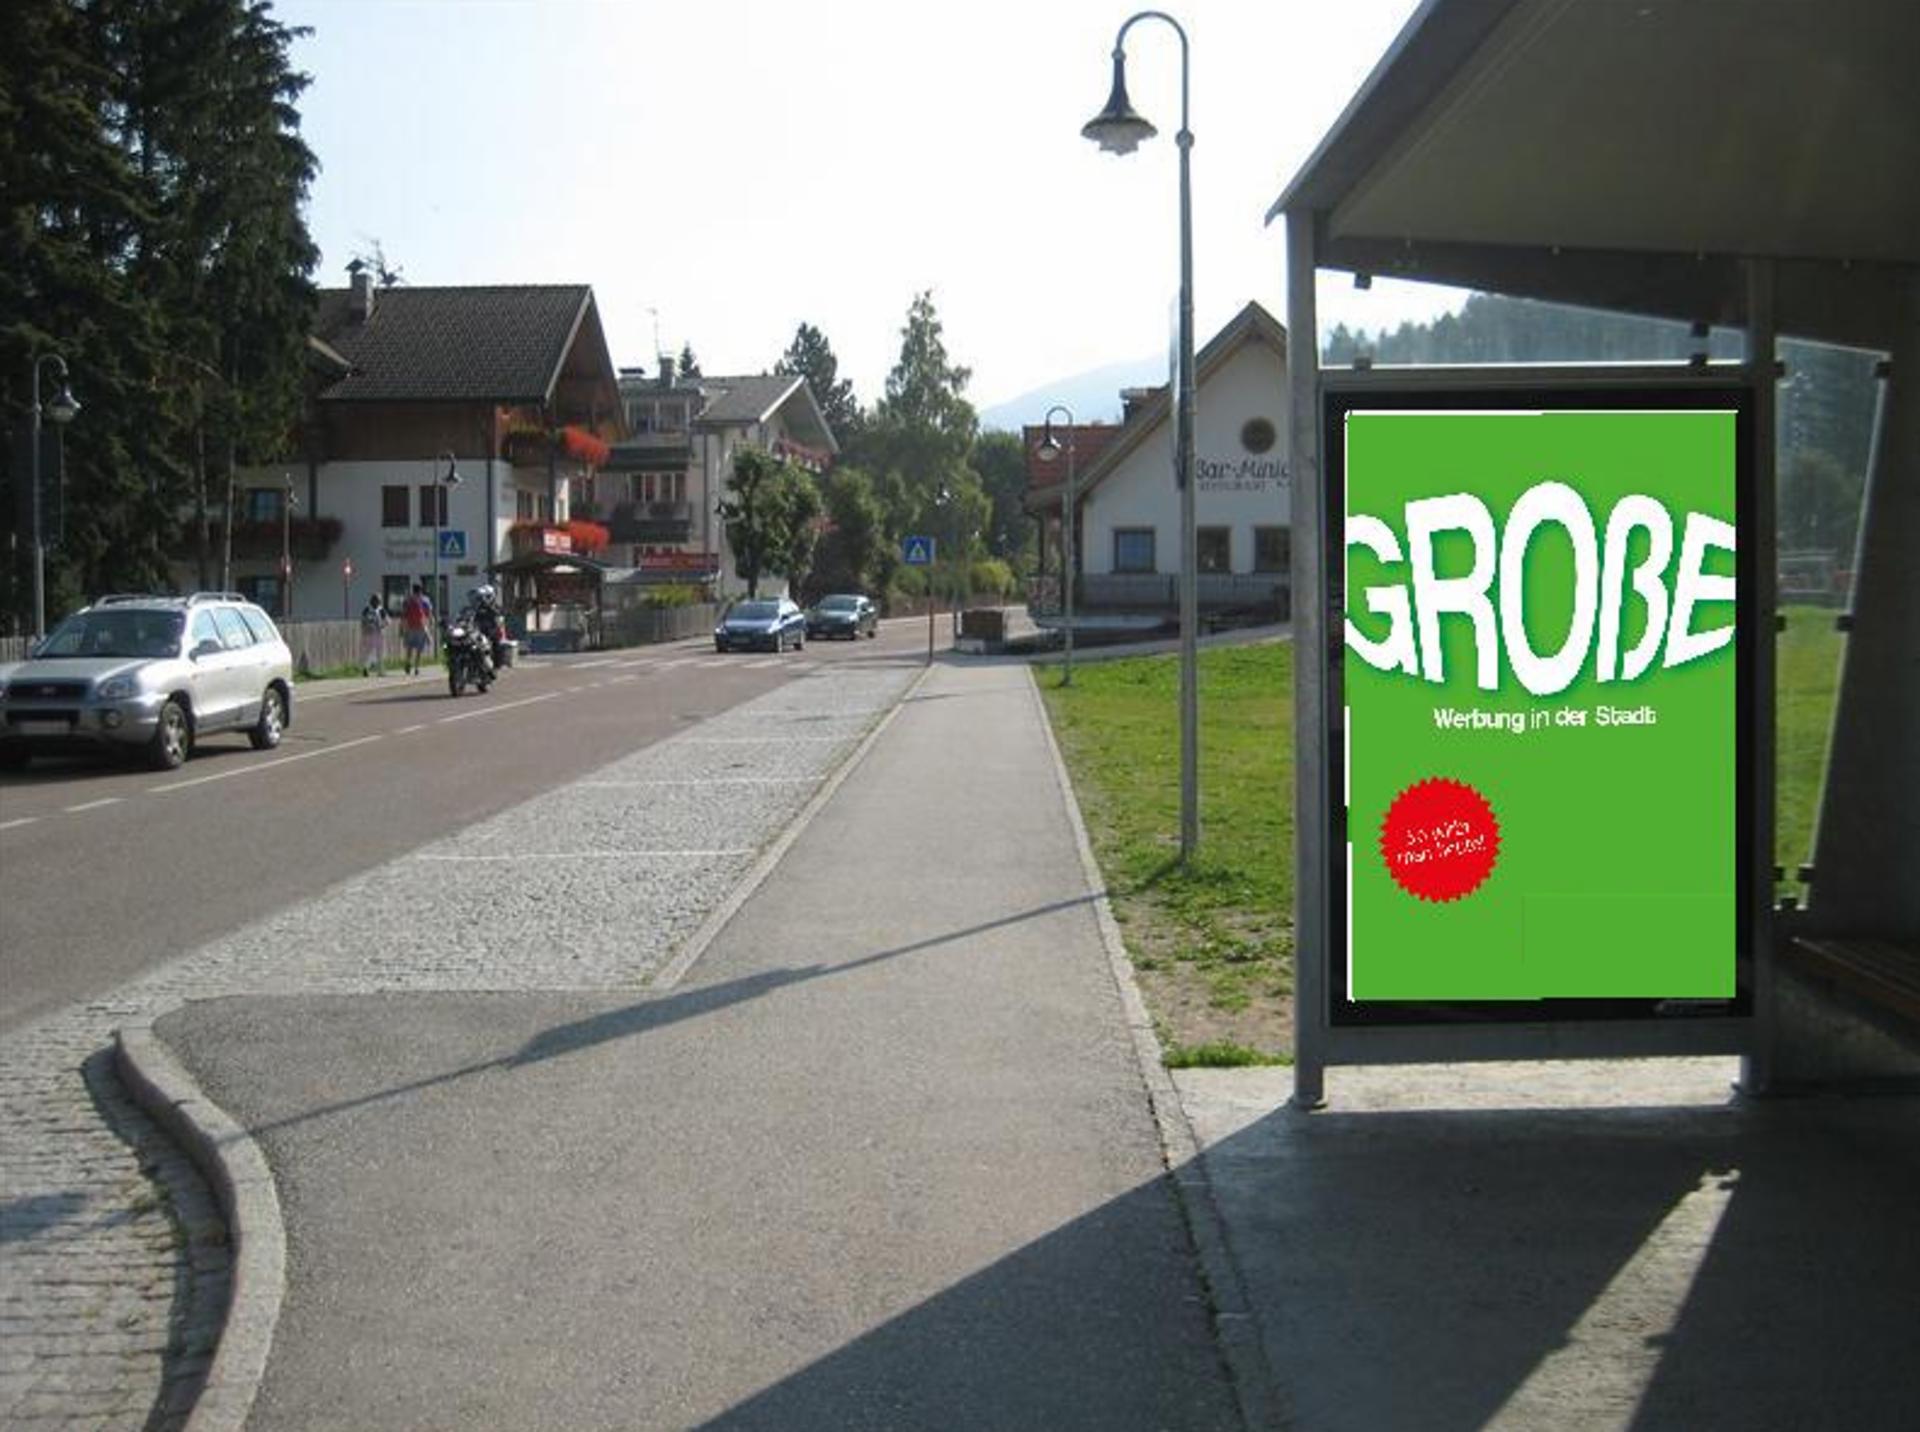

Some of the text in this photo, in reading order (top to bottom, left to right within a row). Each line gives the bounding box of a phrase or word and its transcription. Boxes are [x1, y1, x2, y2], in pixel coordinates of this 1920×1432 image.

[1345, 481, 1736, 695] GROßE
[1433, 706, 1656, 733] Werbung in der Stadt
